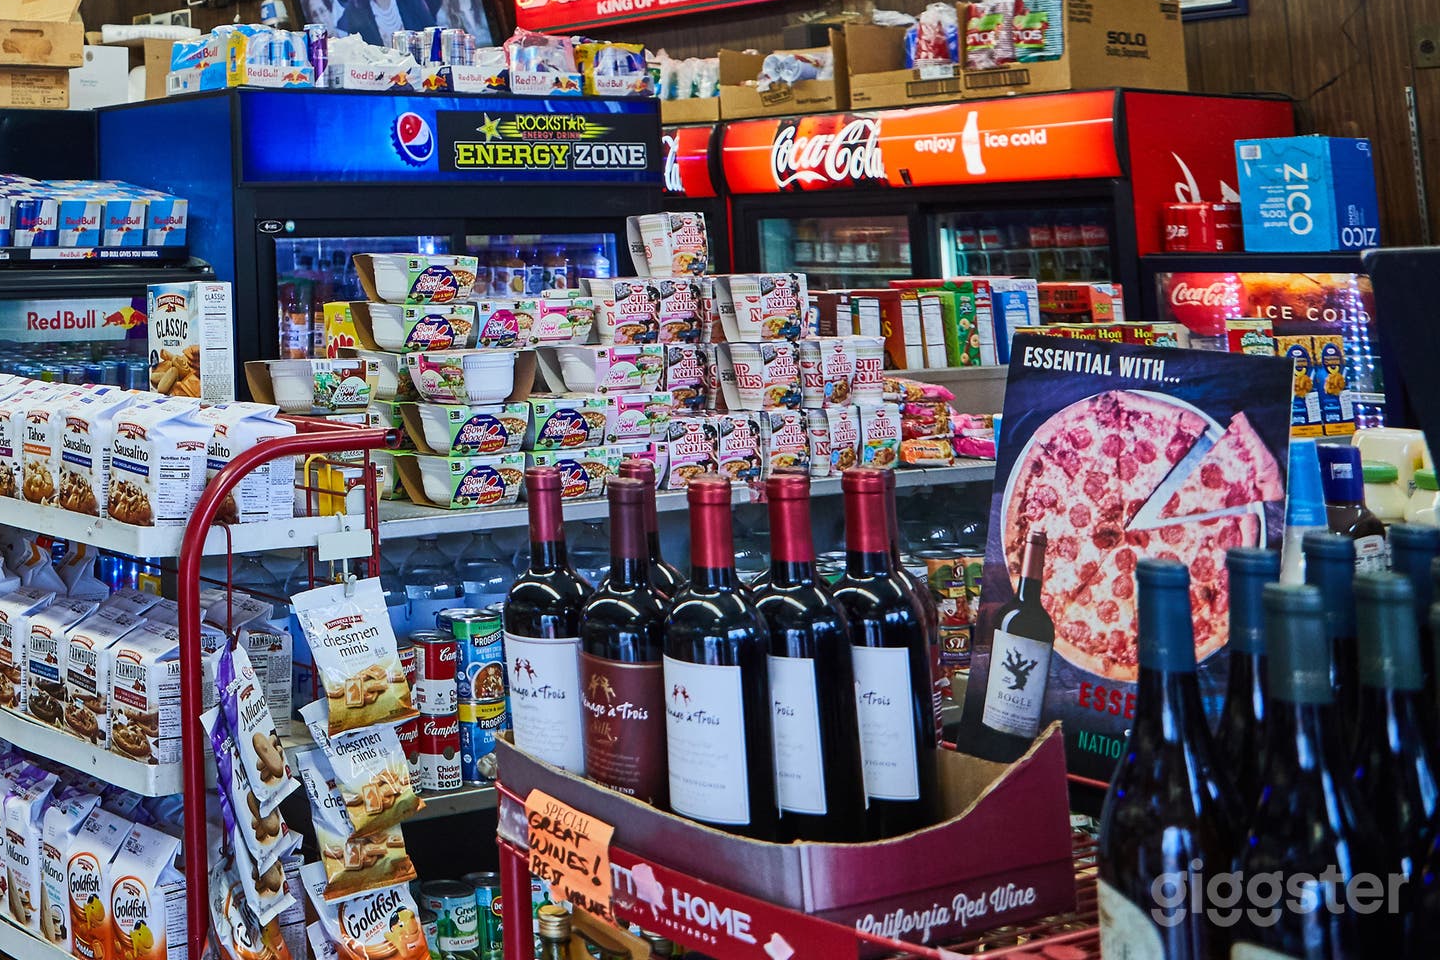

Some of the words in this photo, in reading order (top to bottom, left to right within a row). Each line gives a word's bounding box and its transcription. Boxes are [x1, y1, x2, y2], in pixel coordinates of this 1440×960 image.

[1107, 31, 1147, 46] SOLO
[248, 67, 262, 77] Red
[263, 67, 278, 78] Bull
[351, 69, 368, 80] Red
[522, 131, 555, 139] ENERGY
[555, 131, 581, 139] DRINK
[914, 135, 956, 154] enjoy
[985, 132, 1008, 148] ice
[1010, 129, 1047, 147] cold
[456, 143, 571, 166] ENERGY
[574, 143, 646, 166] ZONE
[772, 113, 886, 187] Coca-Cola
[1283, 162, 1313, 236] ZICO
[1341, 227, 1377, 248] ZICO
[204, 292, 225, 302] CLASSIC
[629, 293, 649, 304] CUP
[673, 293, 691, 303] CUP
[767, 298, 797, 308] NOODLES
[773, 289, 791, 299] CUP
[1171, 282, 1238, 307] Coca-Cola
[621, 302, 655, 314] NOODLES
[666, 302, 697, 312] NOODLES
[1257, 306, 1293, 320] ICE
[1306, 307, 1371, 324] COLD
[27, 310, 62, 331] Red
[63, 309, 98, 330] Bull
[156, 320, 188, 340] CLASSIC
[1023, 346, 1113, 375] ESSENTIAL
[1119, 356, 1180, 383] WITH...
[27, 427, 46, 442] Tahoe
[464, 425, 488, 438] Bowl
[545, 426, 576, 438] Noodle
[546, 418, 570, 433] Bowl
[63, 436, 91, 454] Sausalito
[460, 431, 494, 444] Noodle
[684, 434, 705, 444] CUP
[113, 440, 149, 461] Sausalito
[676, 443, 712, 455] NOODLES
[460, 483, 492, 495] Noodle
[464, 476, 487, 490] Bowl
[30, 637, 58, 655] FARMHOUSE
[323, 626, 378, 648] chessmen
[69, 644, 97, 667] FARMHOUSE
[339, 642, 369, 658] minis
[115, 660, 146, 682] FARMHOUSE
[863, 691, 891, 707] Trois
[997, 691, 1032, 709] BOGLE
[240, 695, 267, 732] Milano
[335, 733, 381, 757] chessmen
[543, 801, 591, 838] SPECIAL
[528, 811, 591, 848] GREAT
[6, 841, 29, 866] Milano
[528, 833, 602, 886] WINES!
[69, 872, 101, 893] Goldfish
[114, 897, 148, 919] Goldfish
[348, 888, 402, 940] Goldfish
[671, 887, 758, 945] HOME
[856, 903, 950, 944] California
[952, 892, 988, 927] Red
[989, 882, 1037, 913] Wine
[365, 922, 384, 938] BAKED
